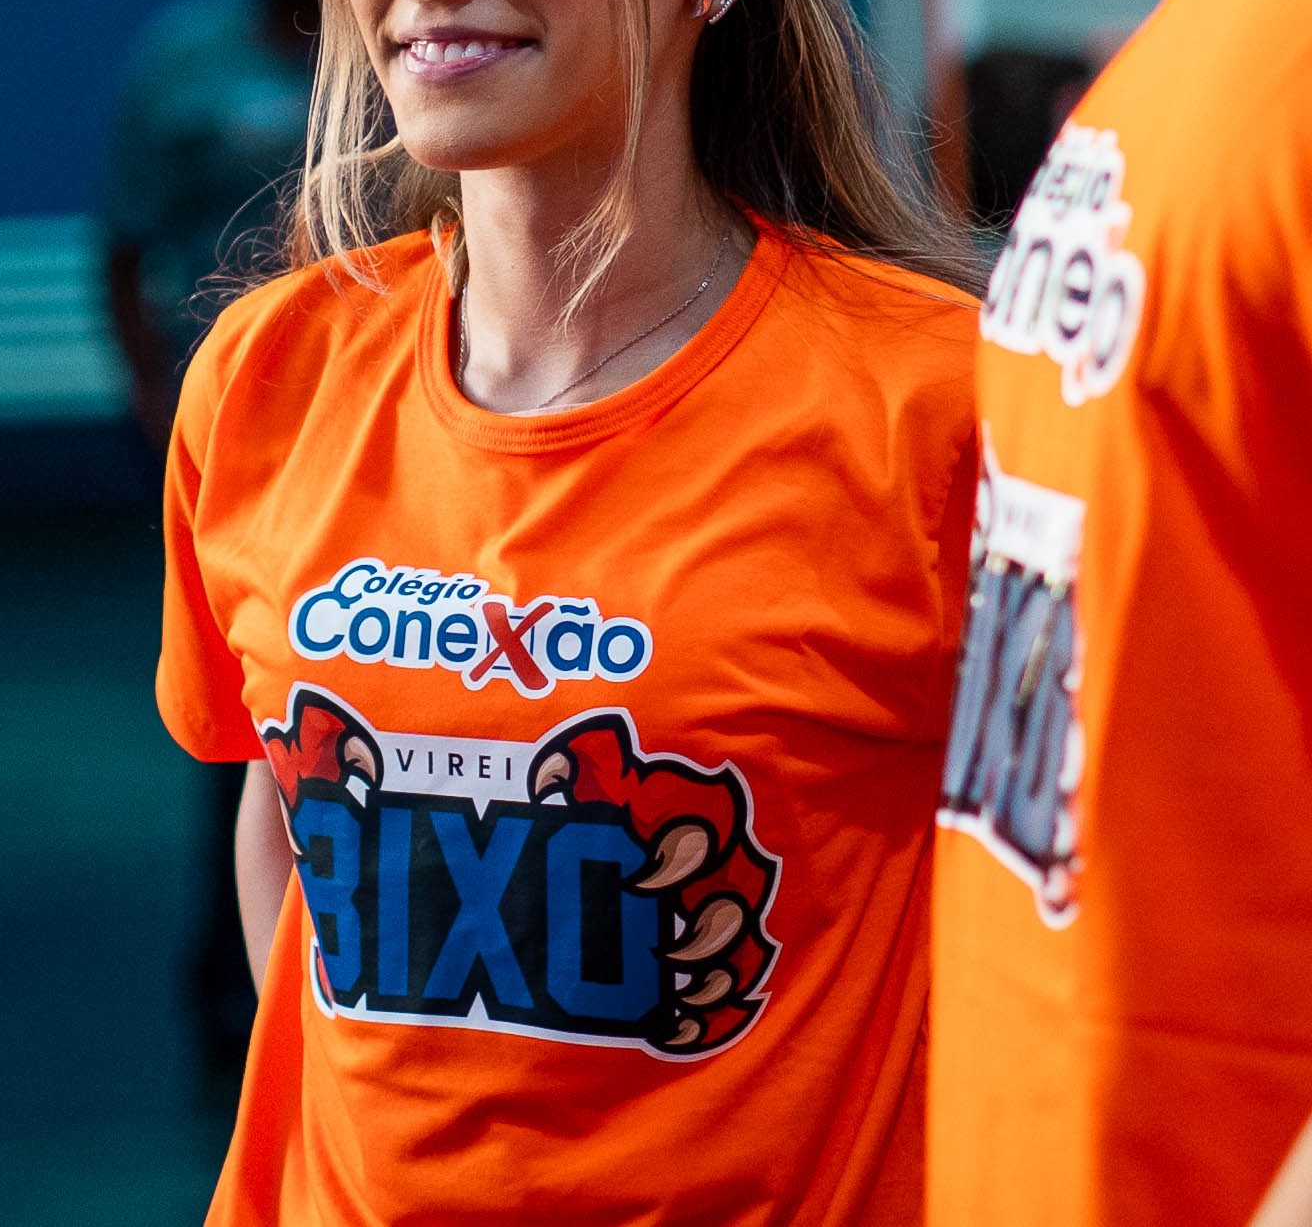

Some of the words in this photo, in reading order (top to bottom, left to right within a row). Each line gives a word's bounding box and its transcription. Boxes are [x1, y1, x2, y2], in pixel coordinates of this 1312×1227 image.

[338, 564, 481, 605] Colégio
[295, 590, 646, 691] ConeXão
[396, 748, 512, 781] VIREI
[293, 797, 659, 1023] BIXO
